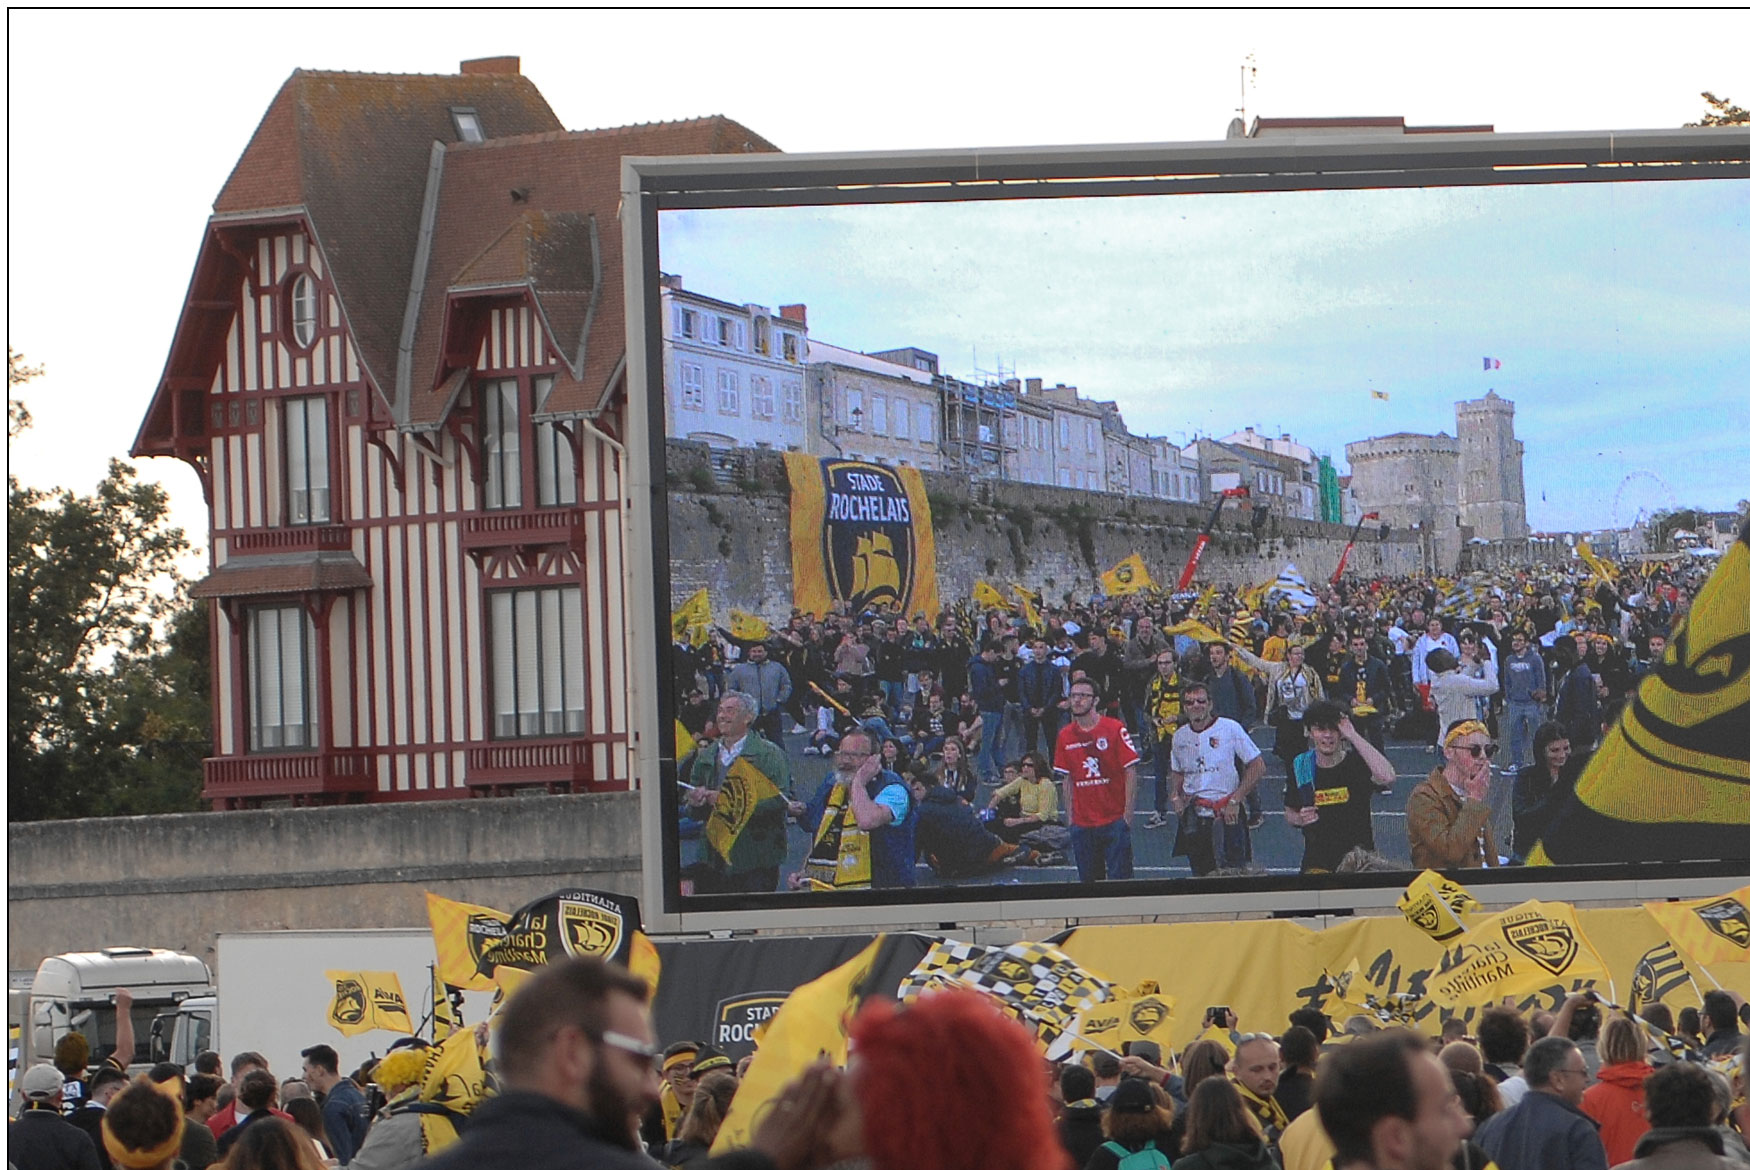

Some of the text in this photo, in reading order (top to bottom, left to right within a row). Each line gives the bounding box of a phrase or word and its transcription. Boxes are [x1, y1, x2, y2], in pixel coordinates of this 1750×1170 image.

[847, 472, 885, 492] STADE
[829, 492, 910, 523] ROCHELAIS
[719, 1023, 759, 1043] ROC
[1086, 1017, 1121, 1029] AVIA
